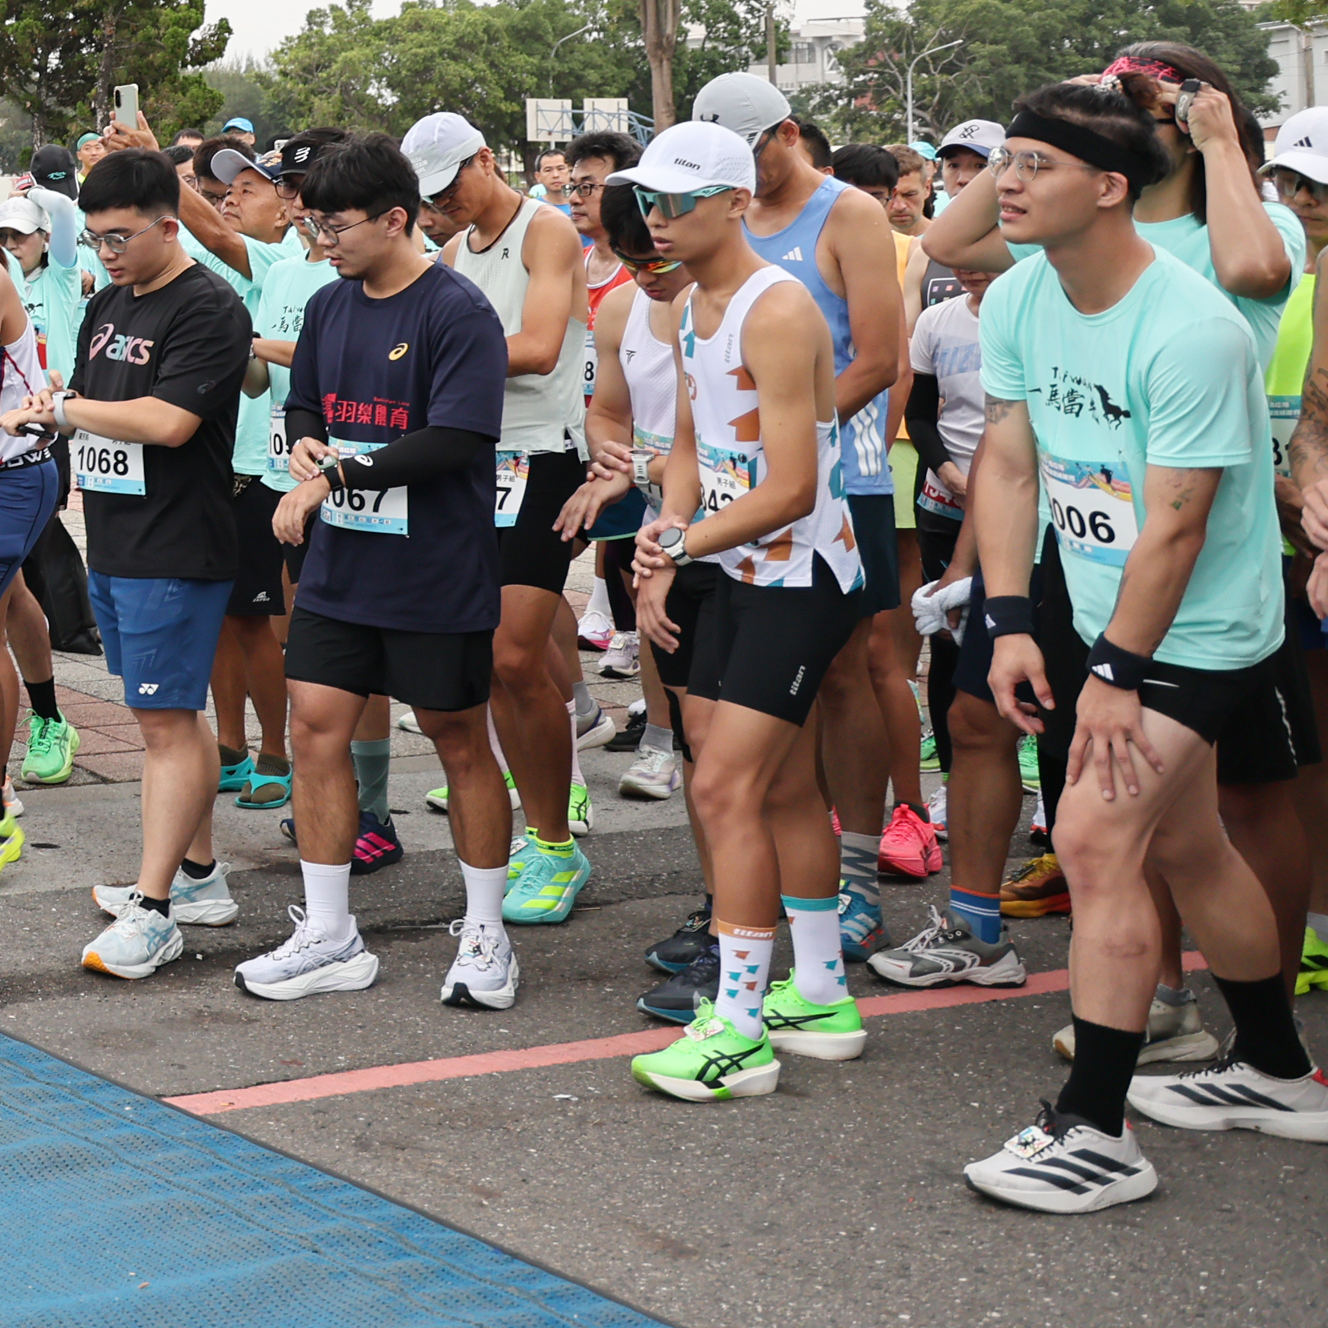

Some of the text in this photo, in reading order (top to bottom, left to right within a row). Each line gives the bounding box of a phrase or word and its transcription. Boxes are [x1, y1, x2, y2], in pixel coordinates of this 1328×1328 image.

[673, 158, 701, 170] titan
[104, 334, 155, 366] asics
[77, 445, 129, 476] 1068
[789, 665, 806, 696] titan
